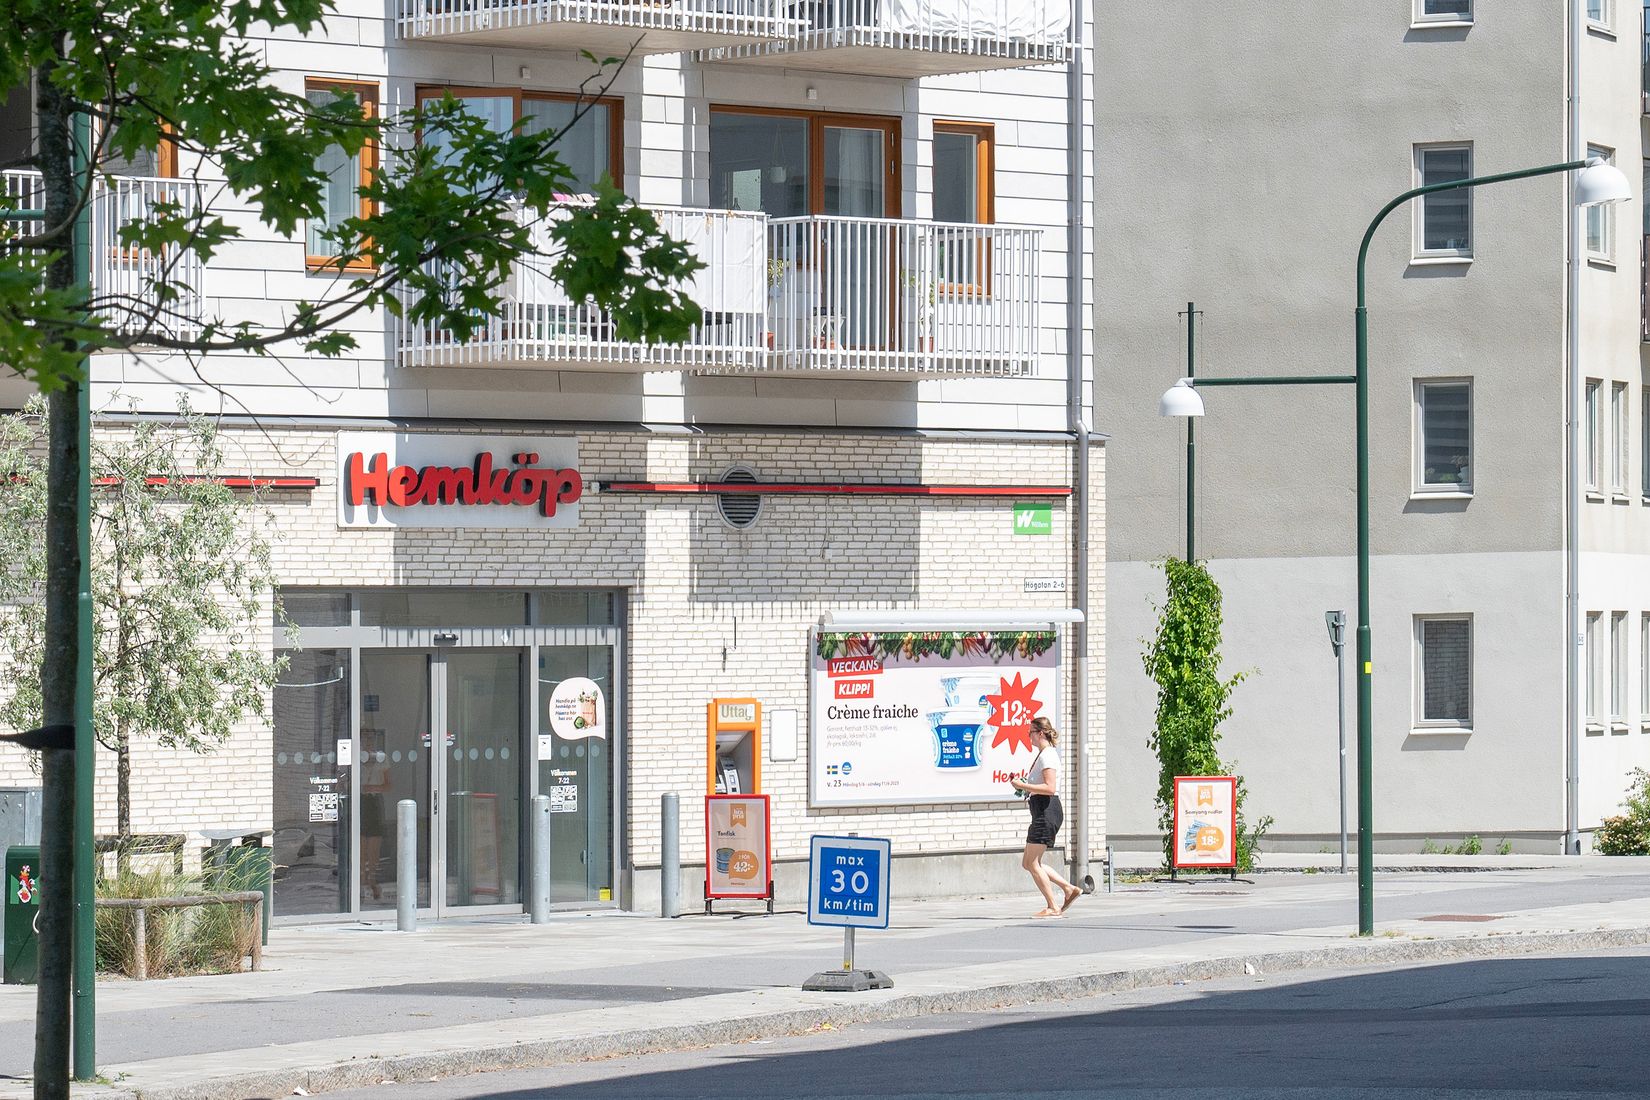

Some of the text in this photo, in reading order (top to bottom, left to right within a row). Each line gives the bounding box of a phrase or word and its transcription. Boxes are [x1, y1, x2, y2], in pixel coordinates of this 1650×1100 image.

[350, 451, 583, 517] Hemköp
[1053, 580, 1065, 588] 2-6
[832, 659, 879, 674] VECKANS
[838, 682, 871, 696] KLIPP!
[827, 704, 919, 719] Crème fraiche
[1001, 700, 1031, 727] 12:-
[833, 779, 842, 788] 23
[1201, 835, 1219, 846] 18:-
[733, 861, 754, 873] 42:-
[836, 855, 864, 866] max
[830, 869, 869, 894] 30
[824, 897, 874, 912] km/tim
